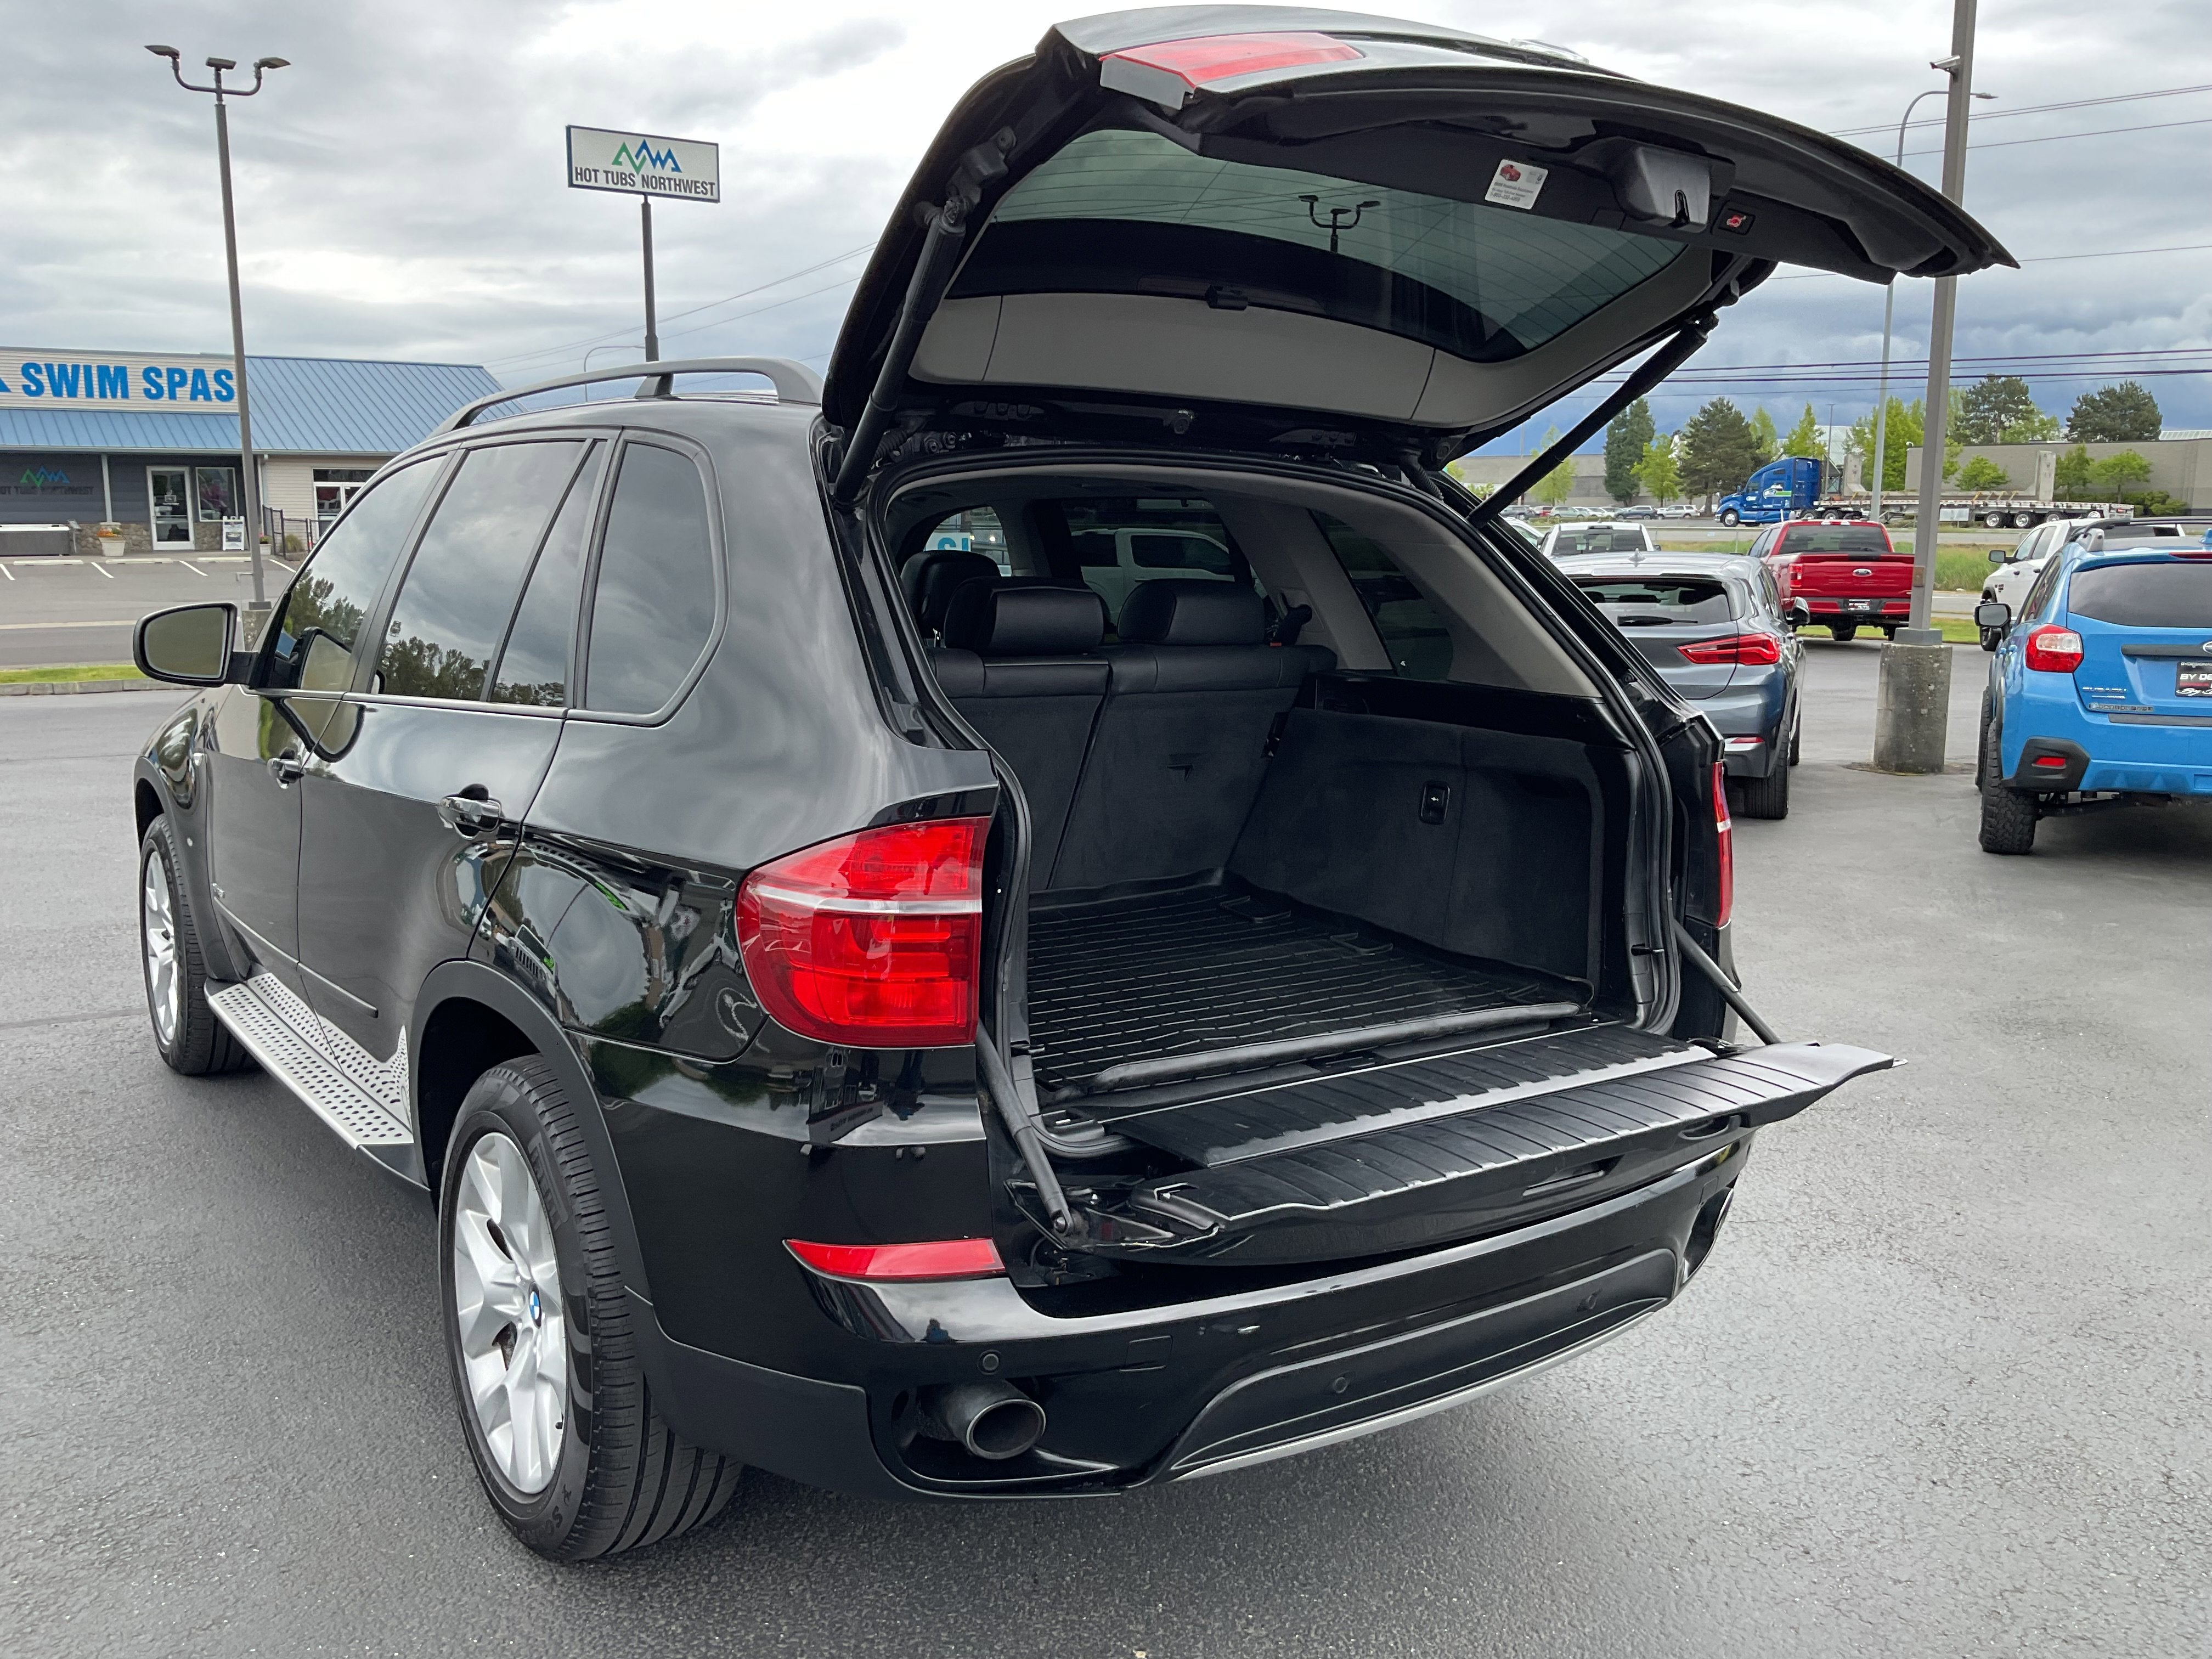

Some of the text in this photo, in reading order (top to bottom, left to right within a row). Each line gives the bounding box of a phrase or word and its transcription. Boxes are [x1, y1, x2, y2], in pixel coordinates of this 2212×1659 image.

[575, 166, 716, 196] HOT TUBS NORTHWEST
[21, 362, 235, 403] SWIM SPAS
